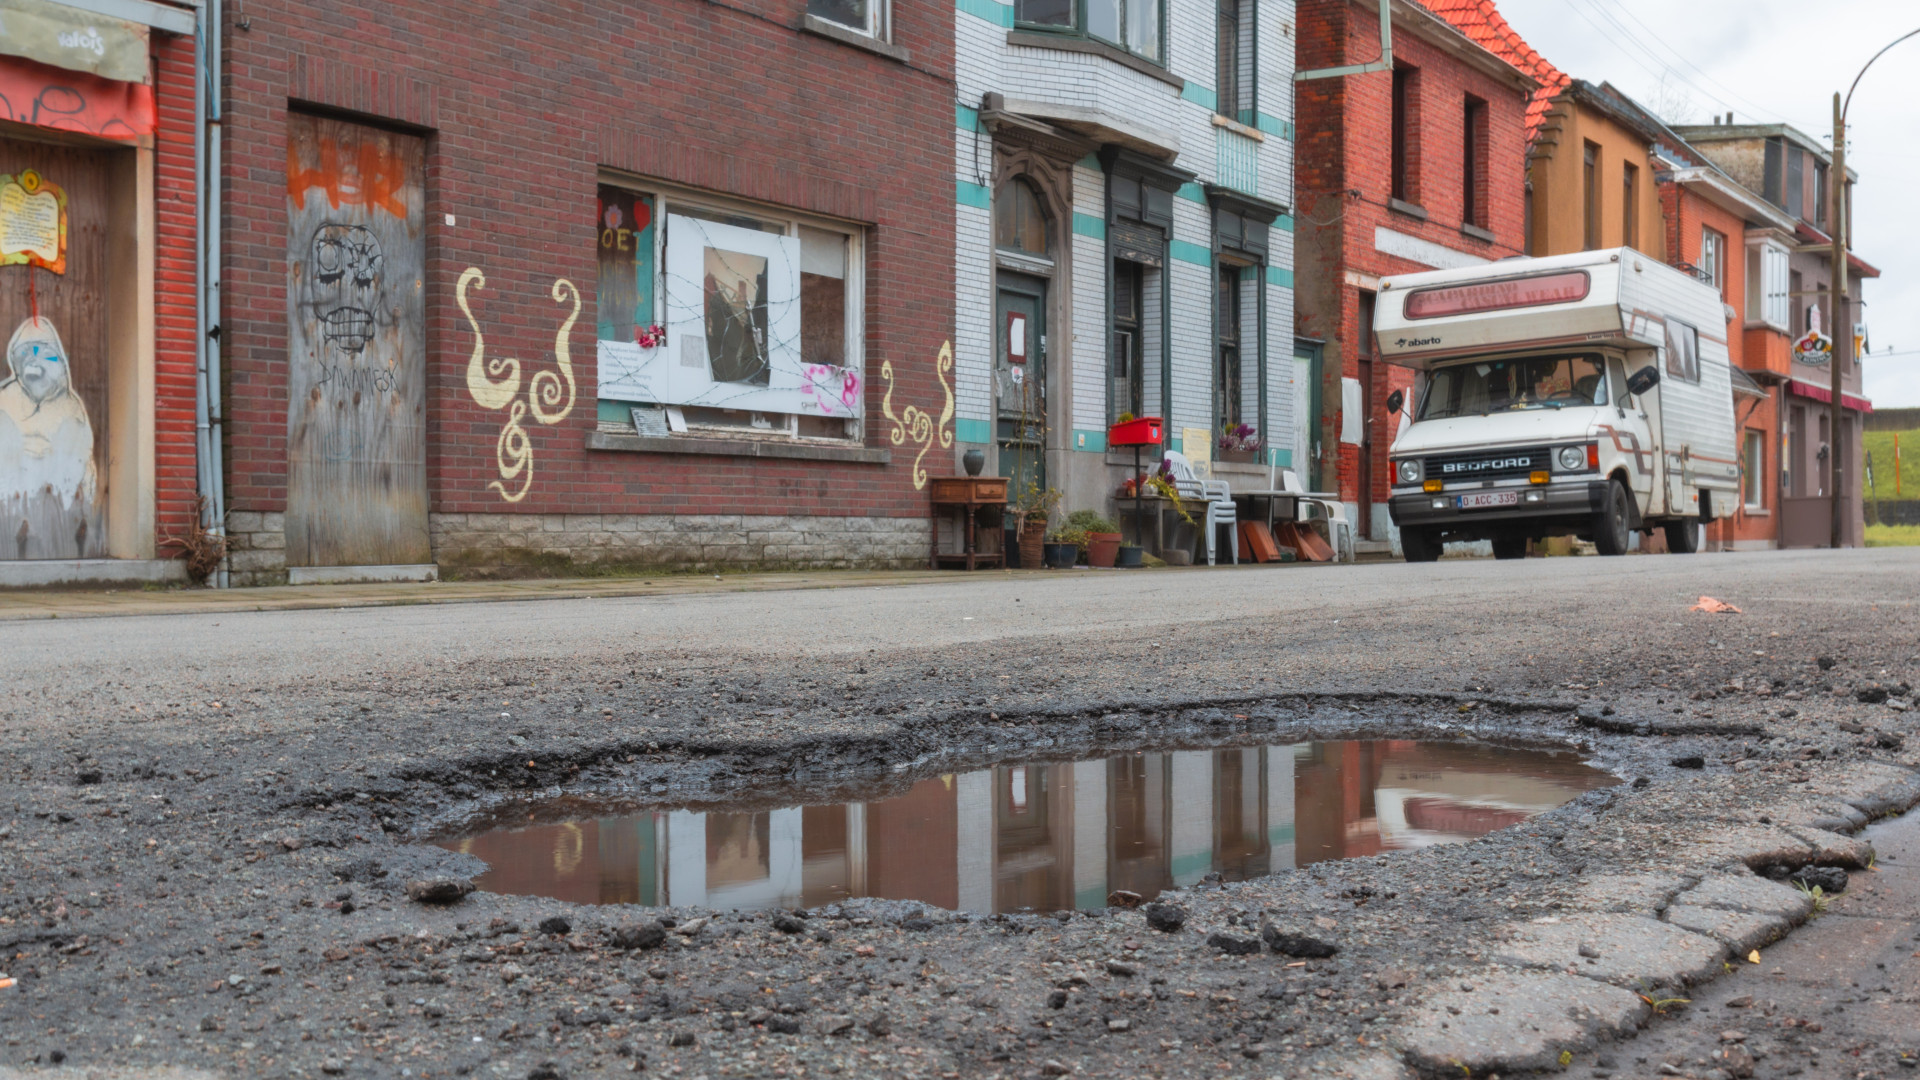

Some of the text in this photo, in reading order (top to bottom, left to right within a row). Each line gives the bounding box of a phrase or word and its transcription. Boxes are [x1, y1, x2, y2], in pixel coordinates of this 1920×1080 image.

[1524, 286, 1575, 301] WEAR
[1408, 336, 1441, 347] abarto
[1443, 458, 1530, 472] BEDFORD
